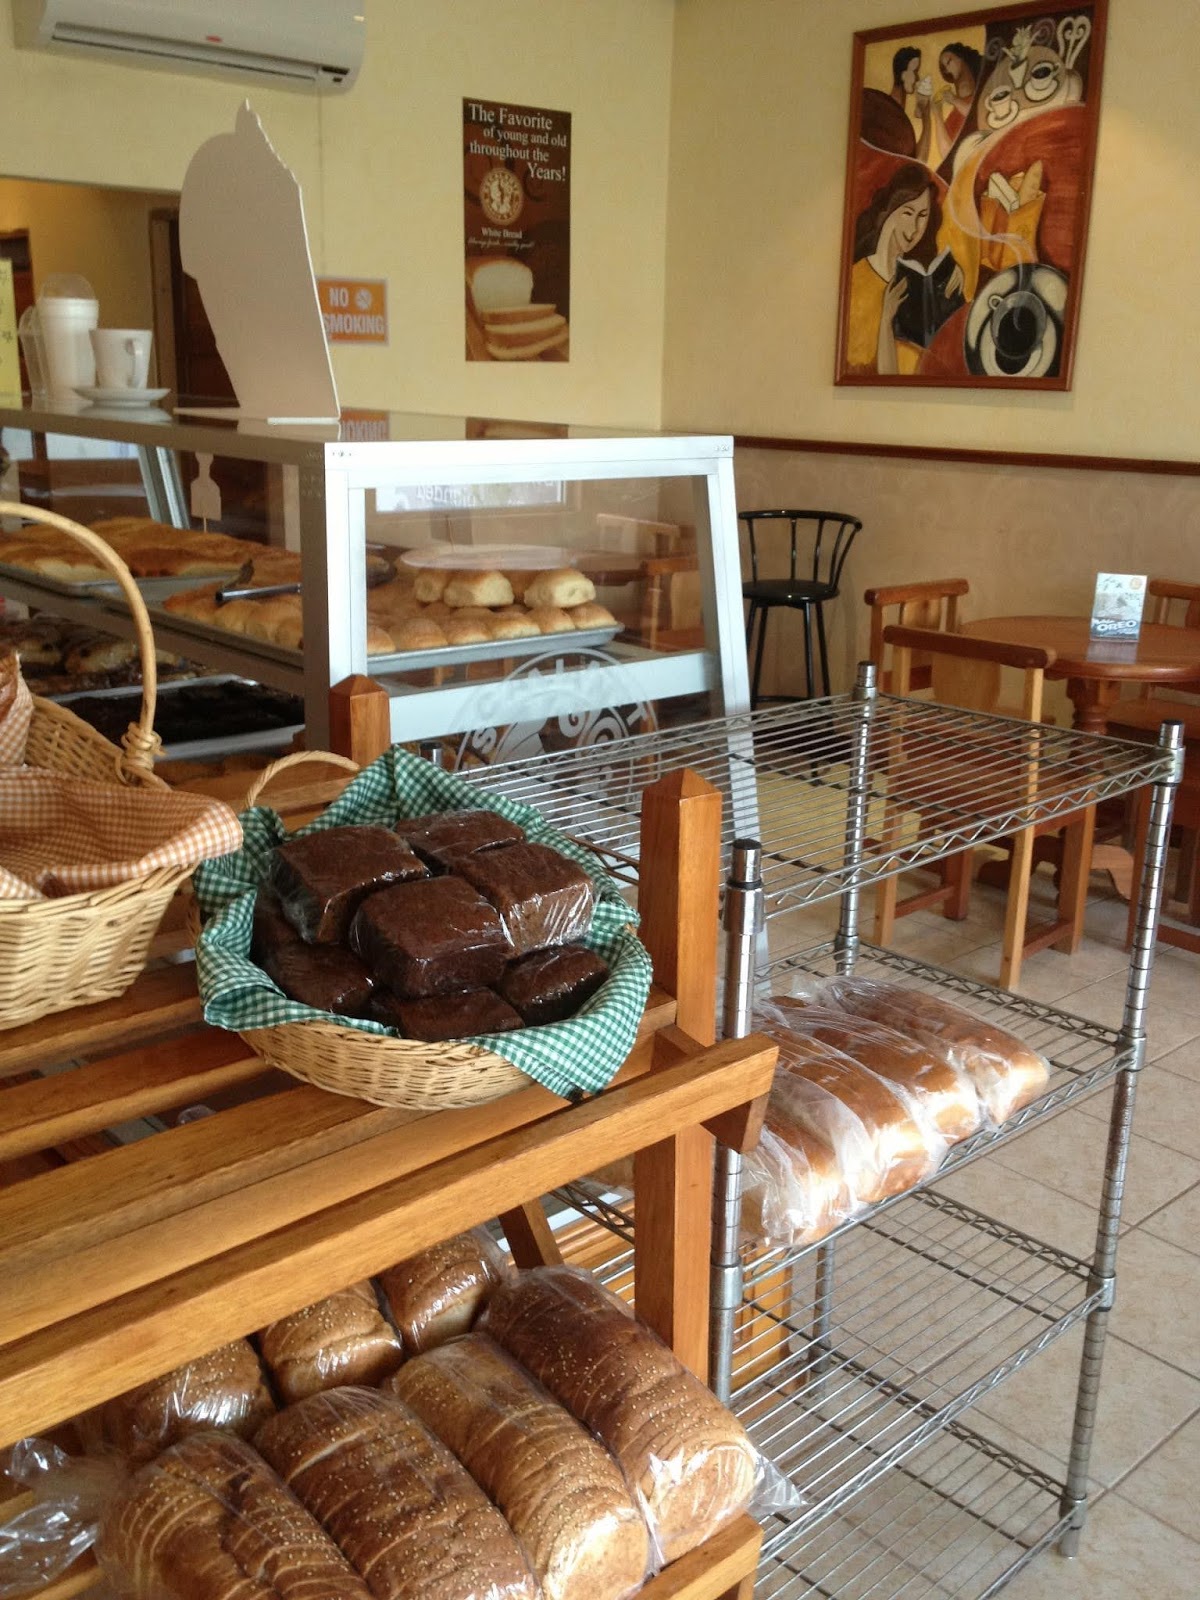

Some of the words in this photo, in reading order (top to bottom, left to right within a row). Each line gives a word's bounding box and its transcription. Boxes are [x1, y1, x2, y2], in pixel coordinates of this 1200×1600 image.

[468, 103, 495, 123] The
[500, 107, 553, 130] Favorite
[483, 125, 496, 138] of
[497, 128, 528, 145] young
[530, 132, 549, 145] and
[551, 134, 567, 147] old
[469, 139, 530, 160] throughout
[533, 147, 549, 162] the
[527, 162, 566, 182] Years!
[329, 287, 349, 307] NO
